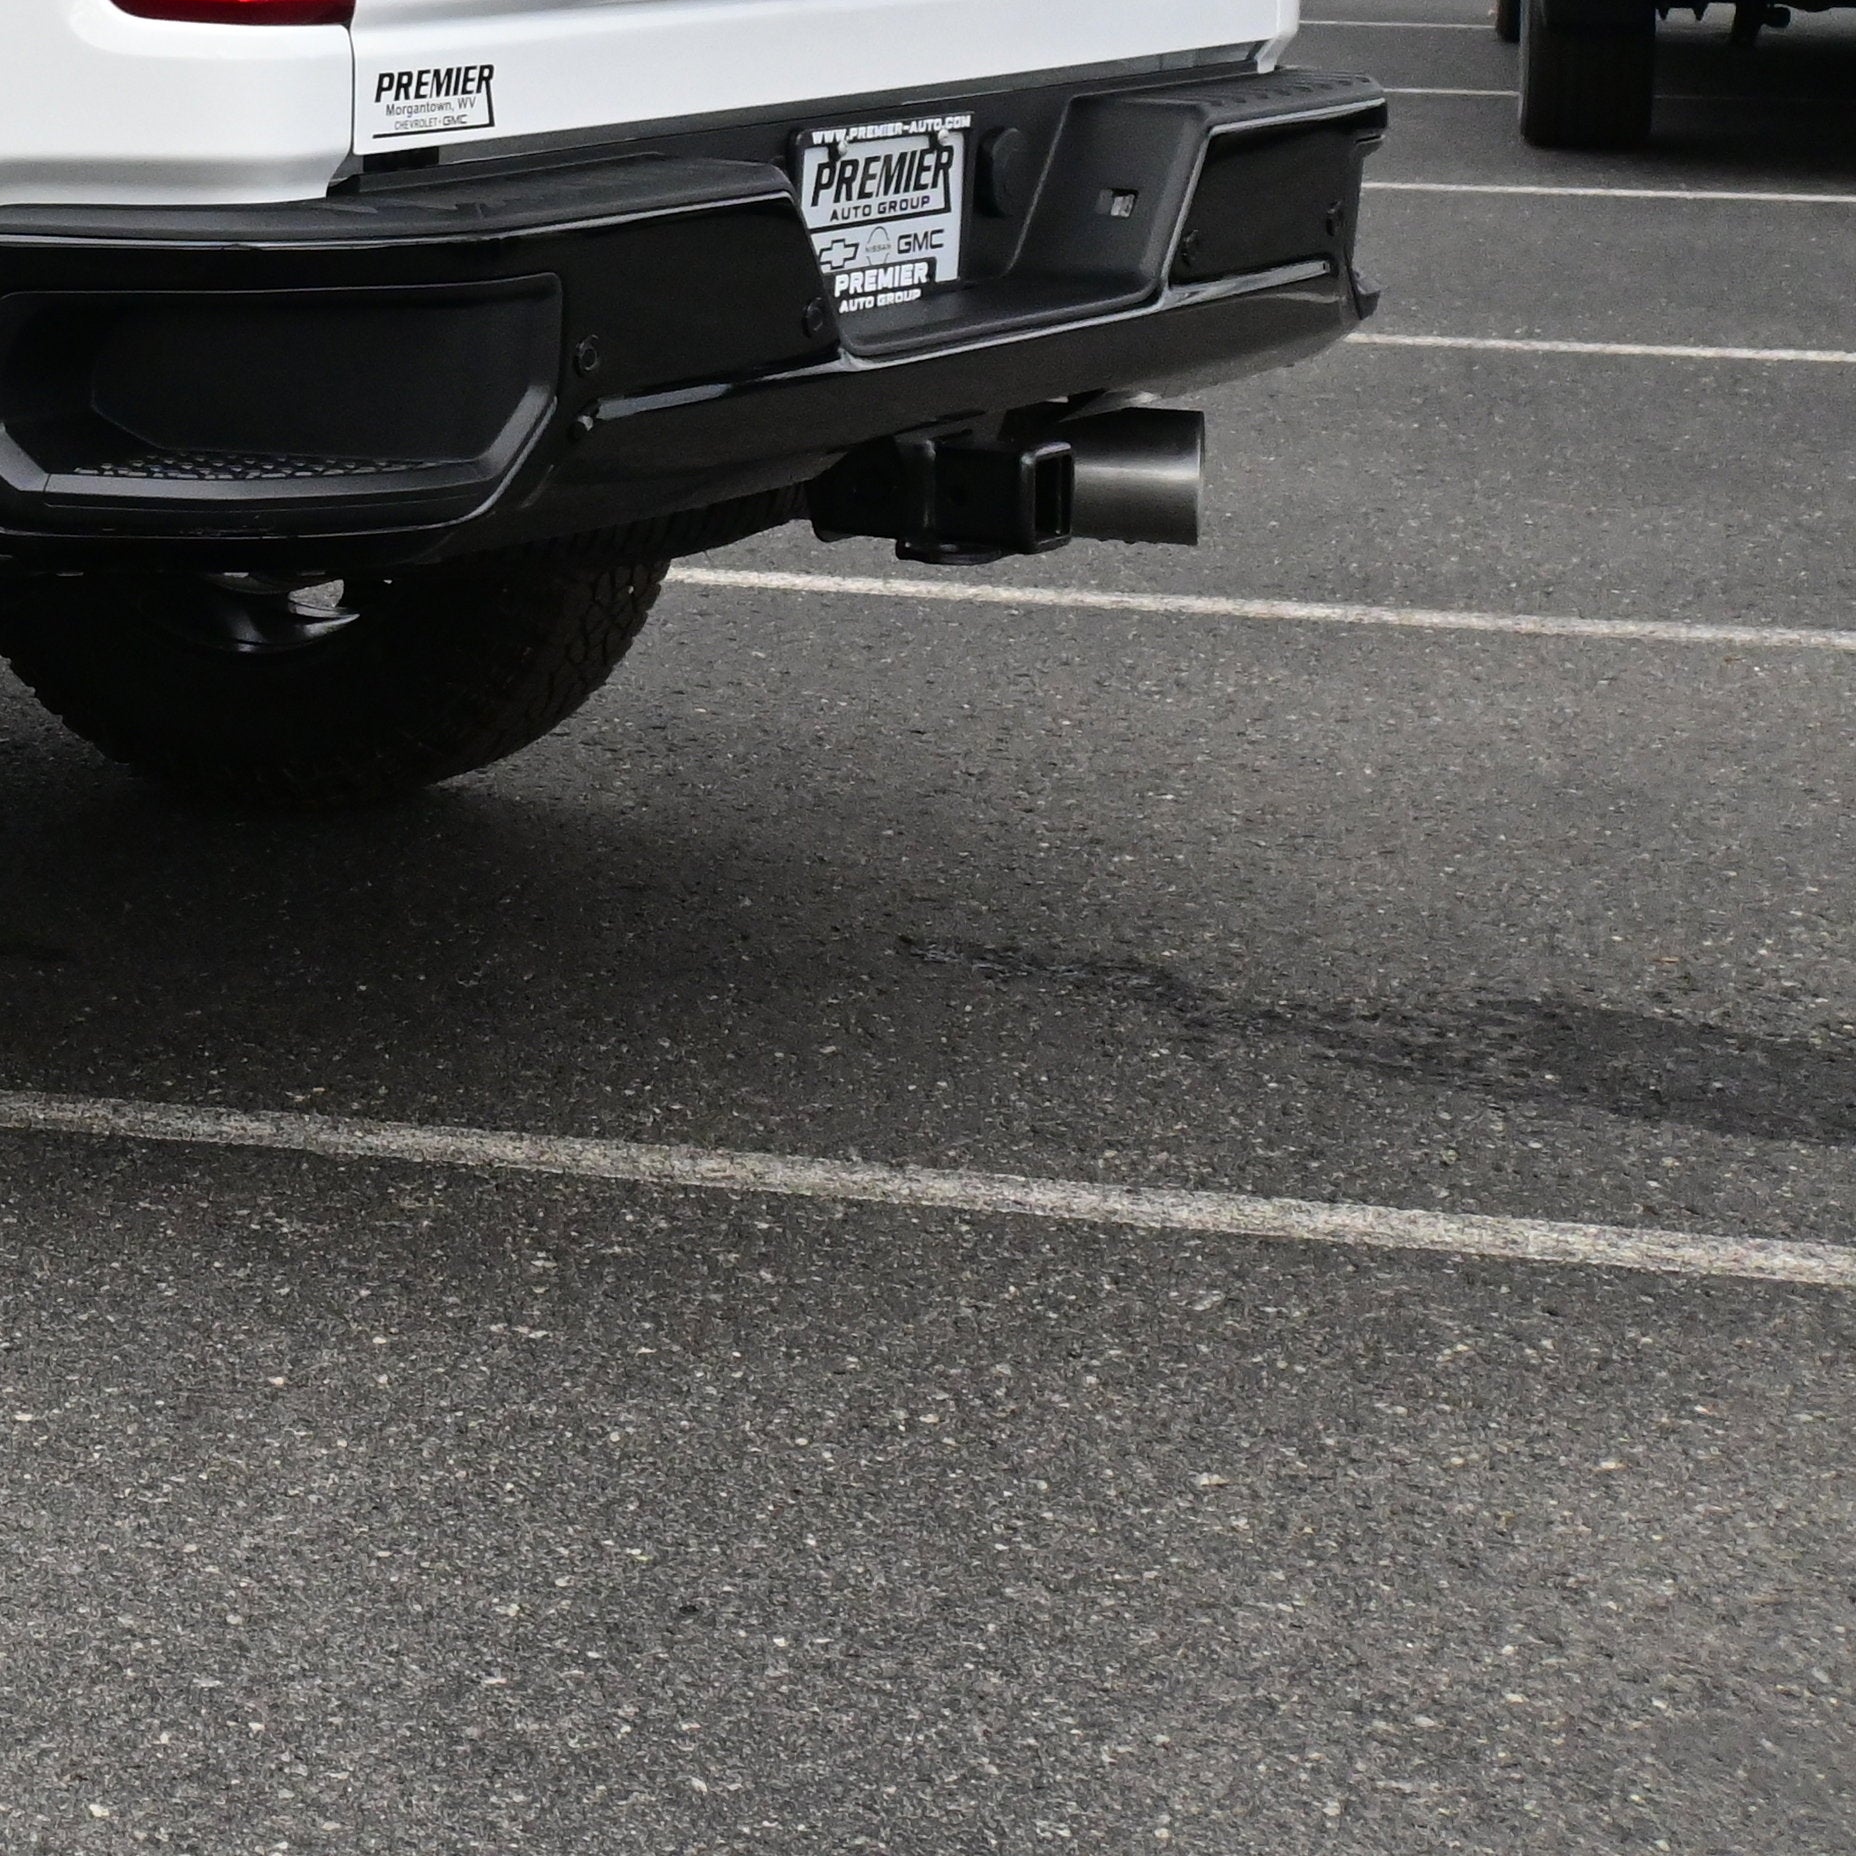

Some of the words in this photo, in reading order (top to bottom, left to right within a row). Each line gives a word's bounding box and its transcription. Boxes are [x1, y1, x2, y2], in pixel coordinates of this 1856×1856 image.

[374, 64, 495, 104] PREMIER
[385, 100, 455, 118] Morgantown,
[457, 96, 477, 110] WV
[811, 114, 972, 145] WWW.PREMIER-AUTO.COM
[810, 144, 955, 208] PREMIER
[829, 204, 873, 223] AUTO
[877, 195, 931, 215] GROUP
[864, 243, 892, 253] NISSAN
[897, 229, 945, 255] GMC
[834, 261, 929, 298] PREMIER
[838, 295, 875, 314] AUTO
[876, 289, 922, 307] GROUP
